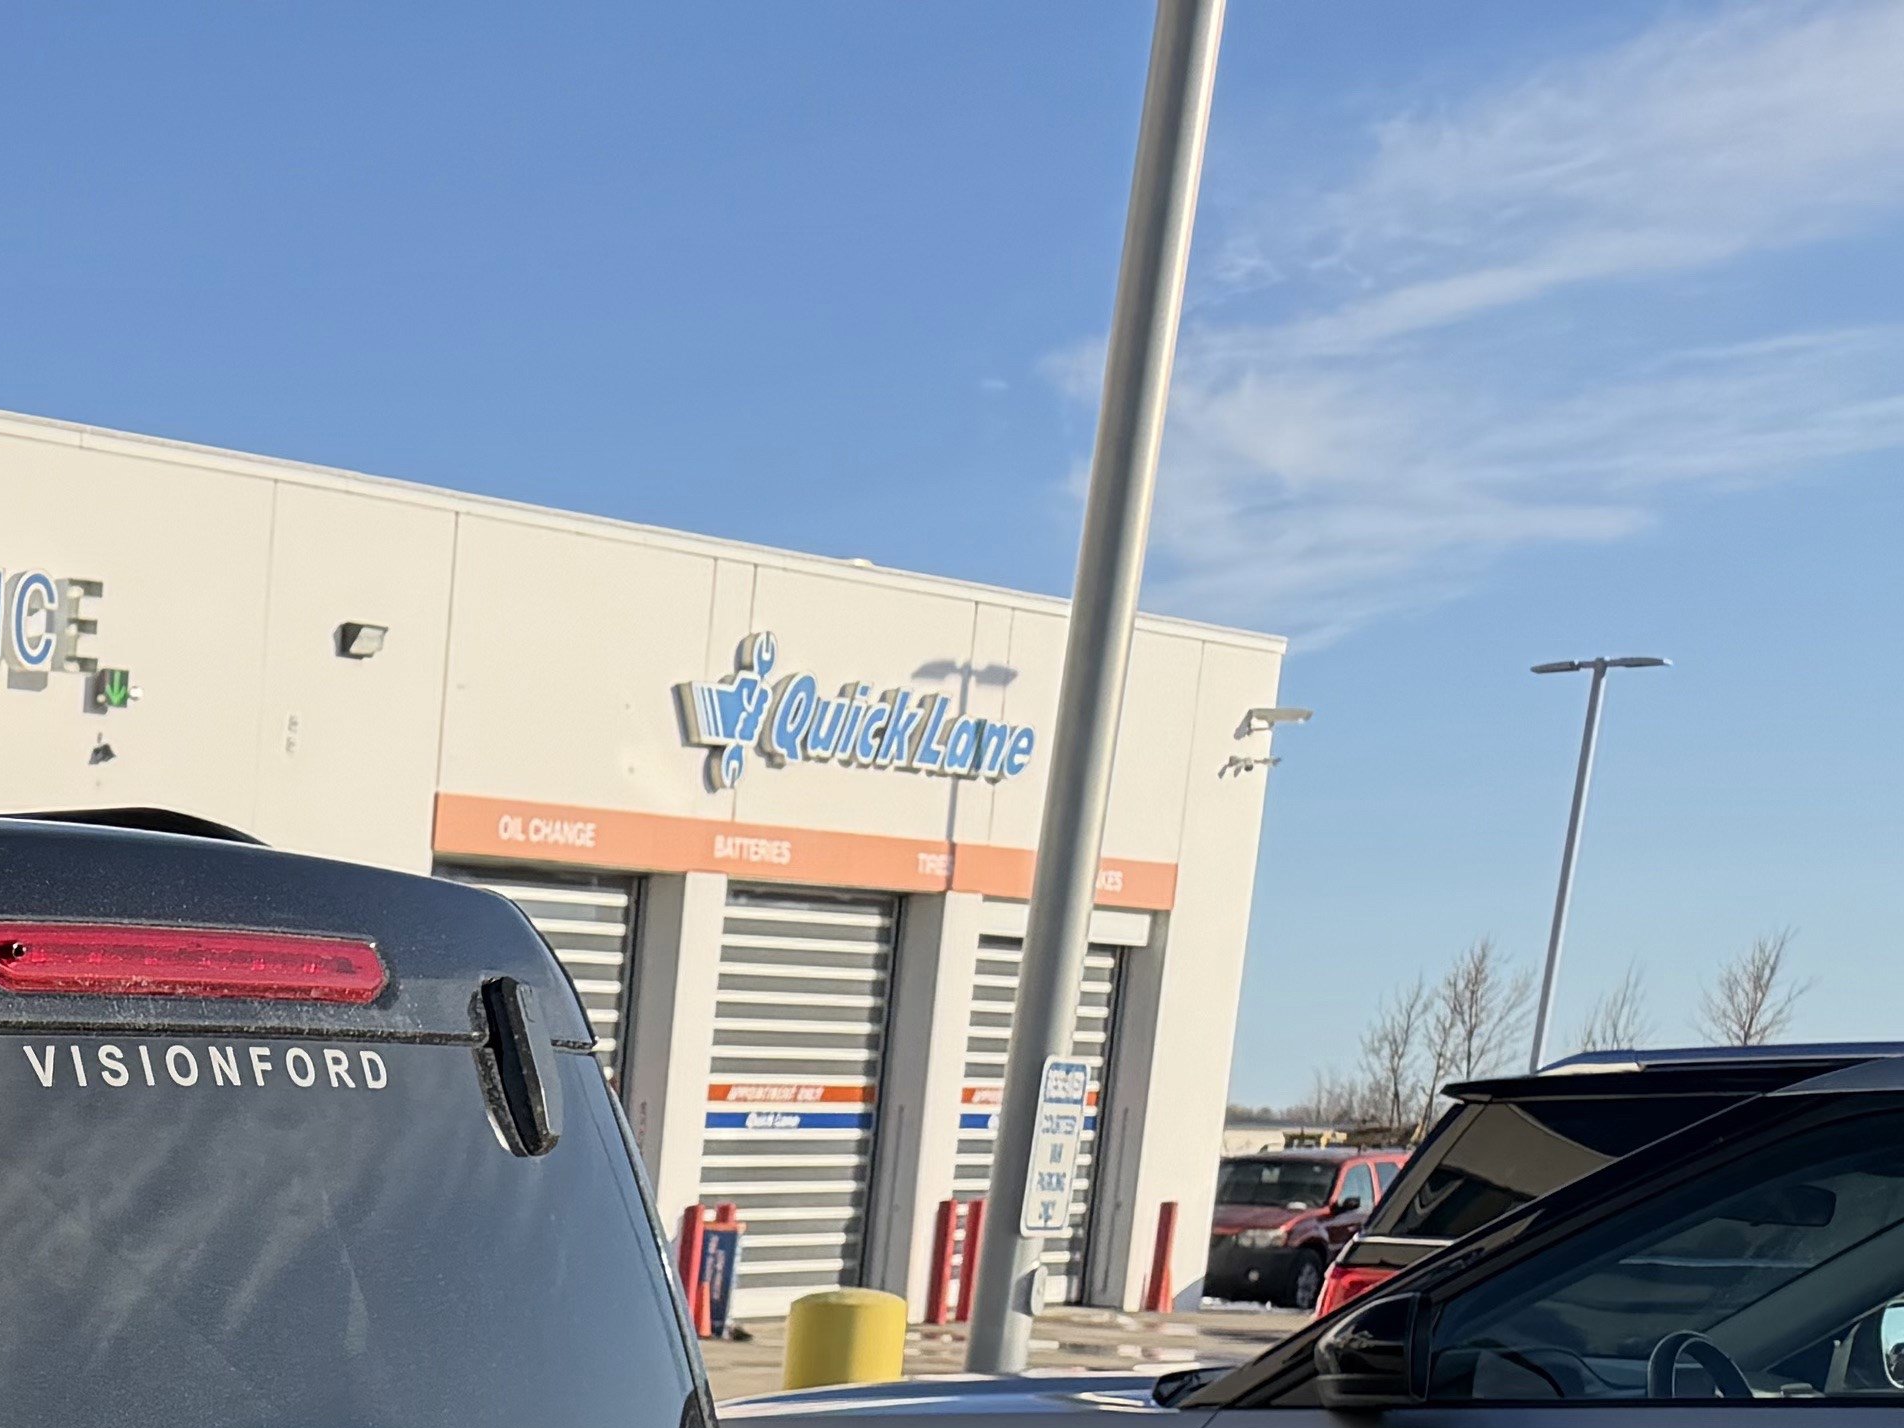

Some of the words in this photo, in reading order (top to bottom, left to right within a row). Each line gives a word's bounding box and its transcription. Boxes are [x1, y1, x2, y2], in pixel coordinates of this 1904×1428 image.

[772, 671, 926, 765] Quick
[913, 694, 1037, 779] Lane
[498, 814, 526, 842] OIL
[528, 817, 597, 848] CHANGE
[713, 834, 793, 866] BATTERIES
[23, 1044, 388, 1090] VISIONFORD
